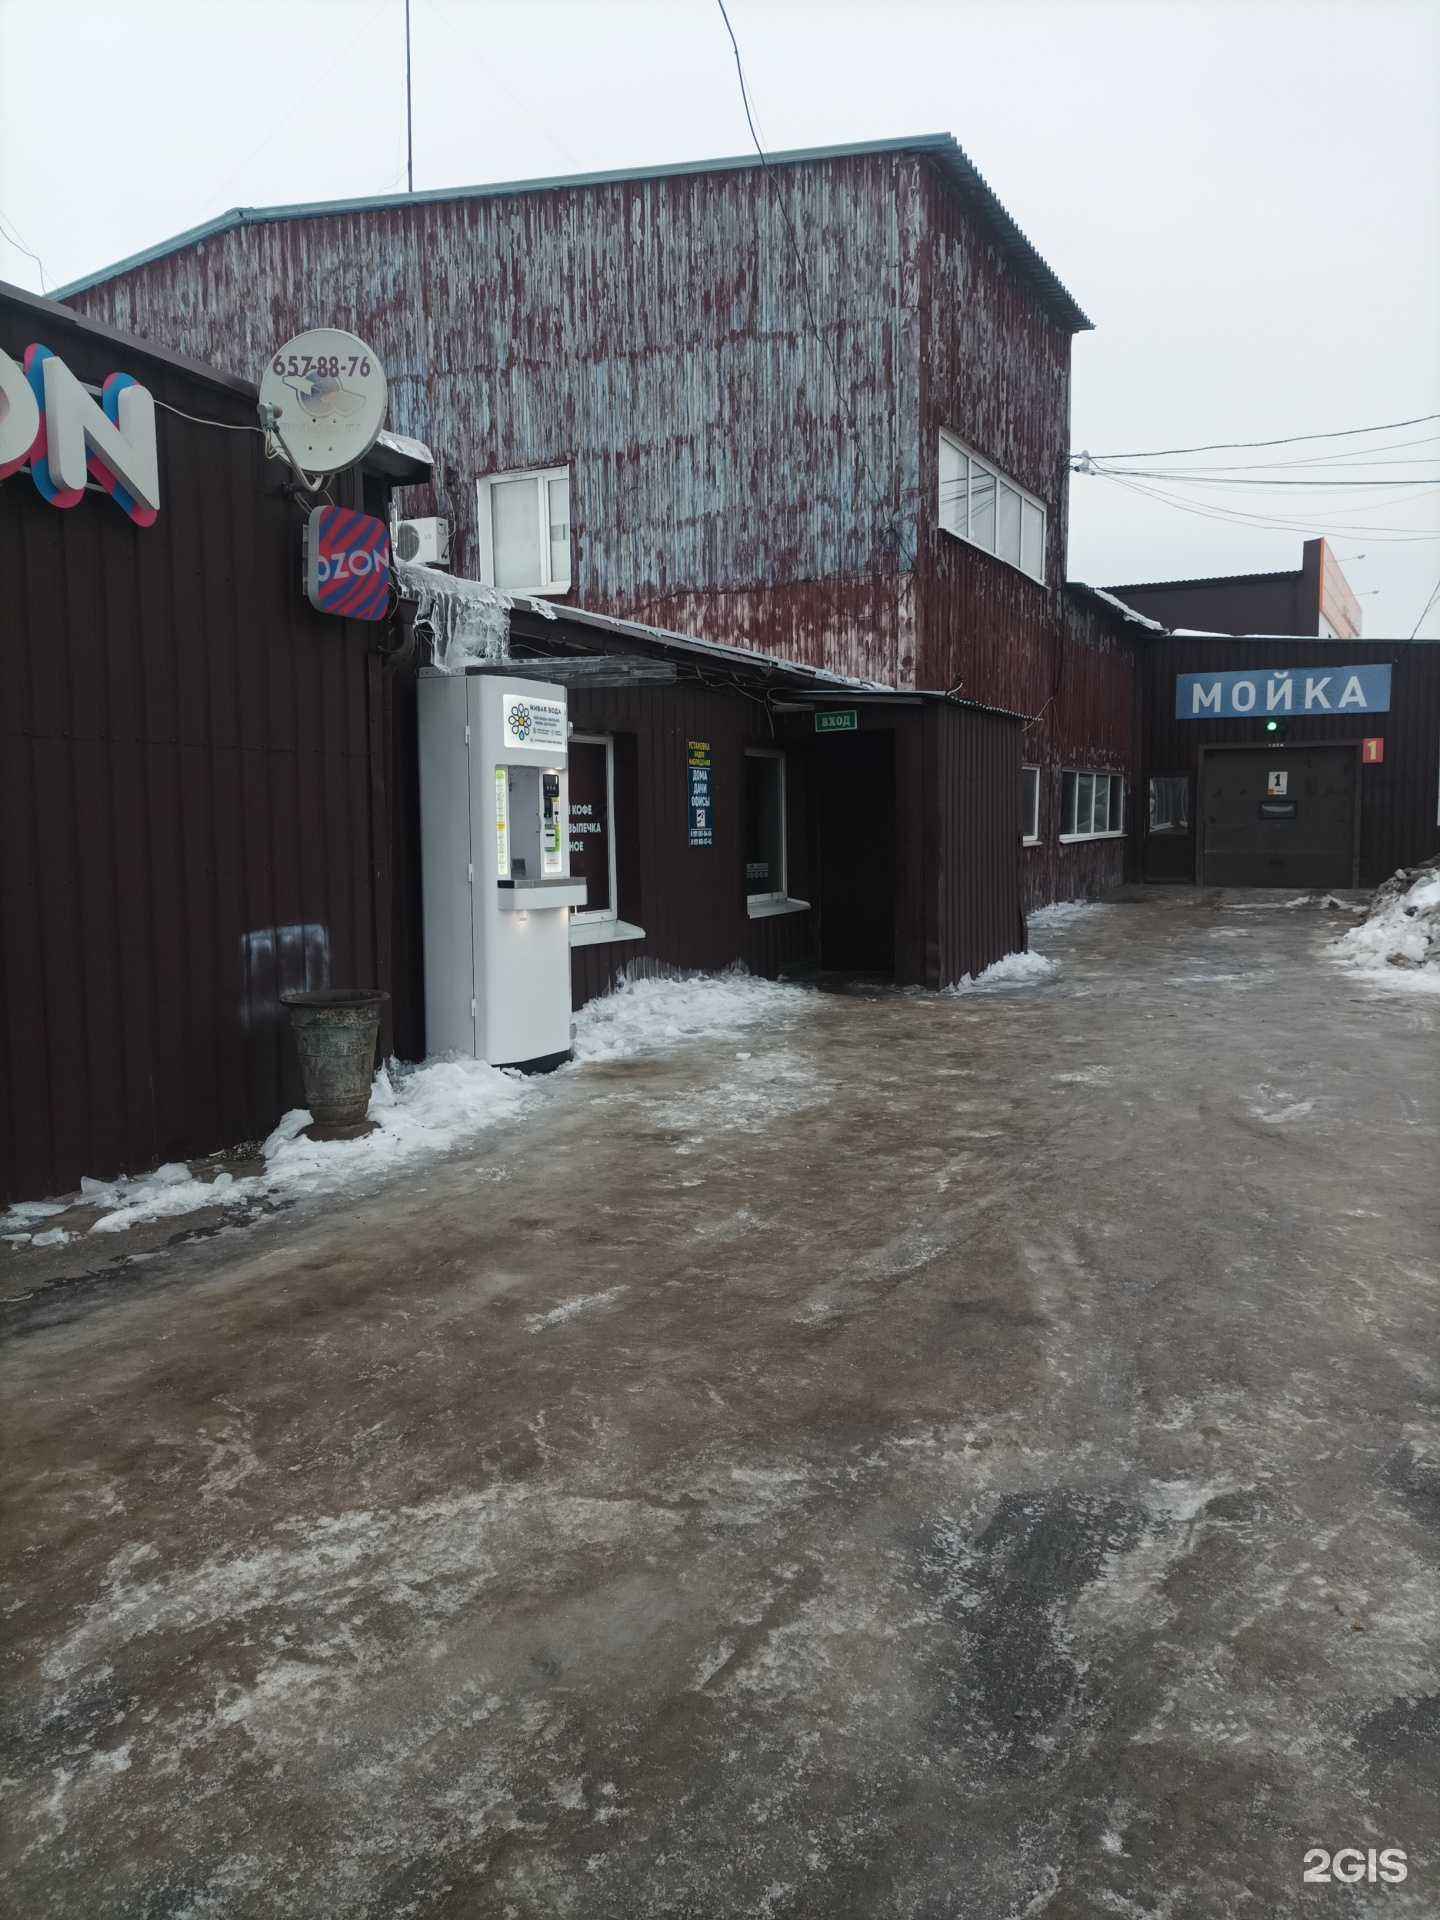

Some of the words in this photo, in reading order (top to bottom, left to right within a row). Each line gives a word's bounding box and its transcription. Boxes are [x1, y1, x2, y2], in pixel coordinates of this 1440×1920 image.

[272, 355, 371, 377] 657-88-76
[317, 547, 389, 582] OZON
[1192, 671, 1368, 714] МОЙКА
[822, 715, 850, 728] ВХОД
[1367, 740, 1377, 760] 1
[692, 769, 708, 781] ДОМА
[1273, 773, 1281, 788] 1
[693, 783, 708, 794] ДАЧИ
[691, 796, 711, 807] ОФИСЫ
[572, 804, 592, 815] КОФЕ
